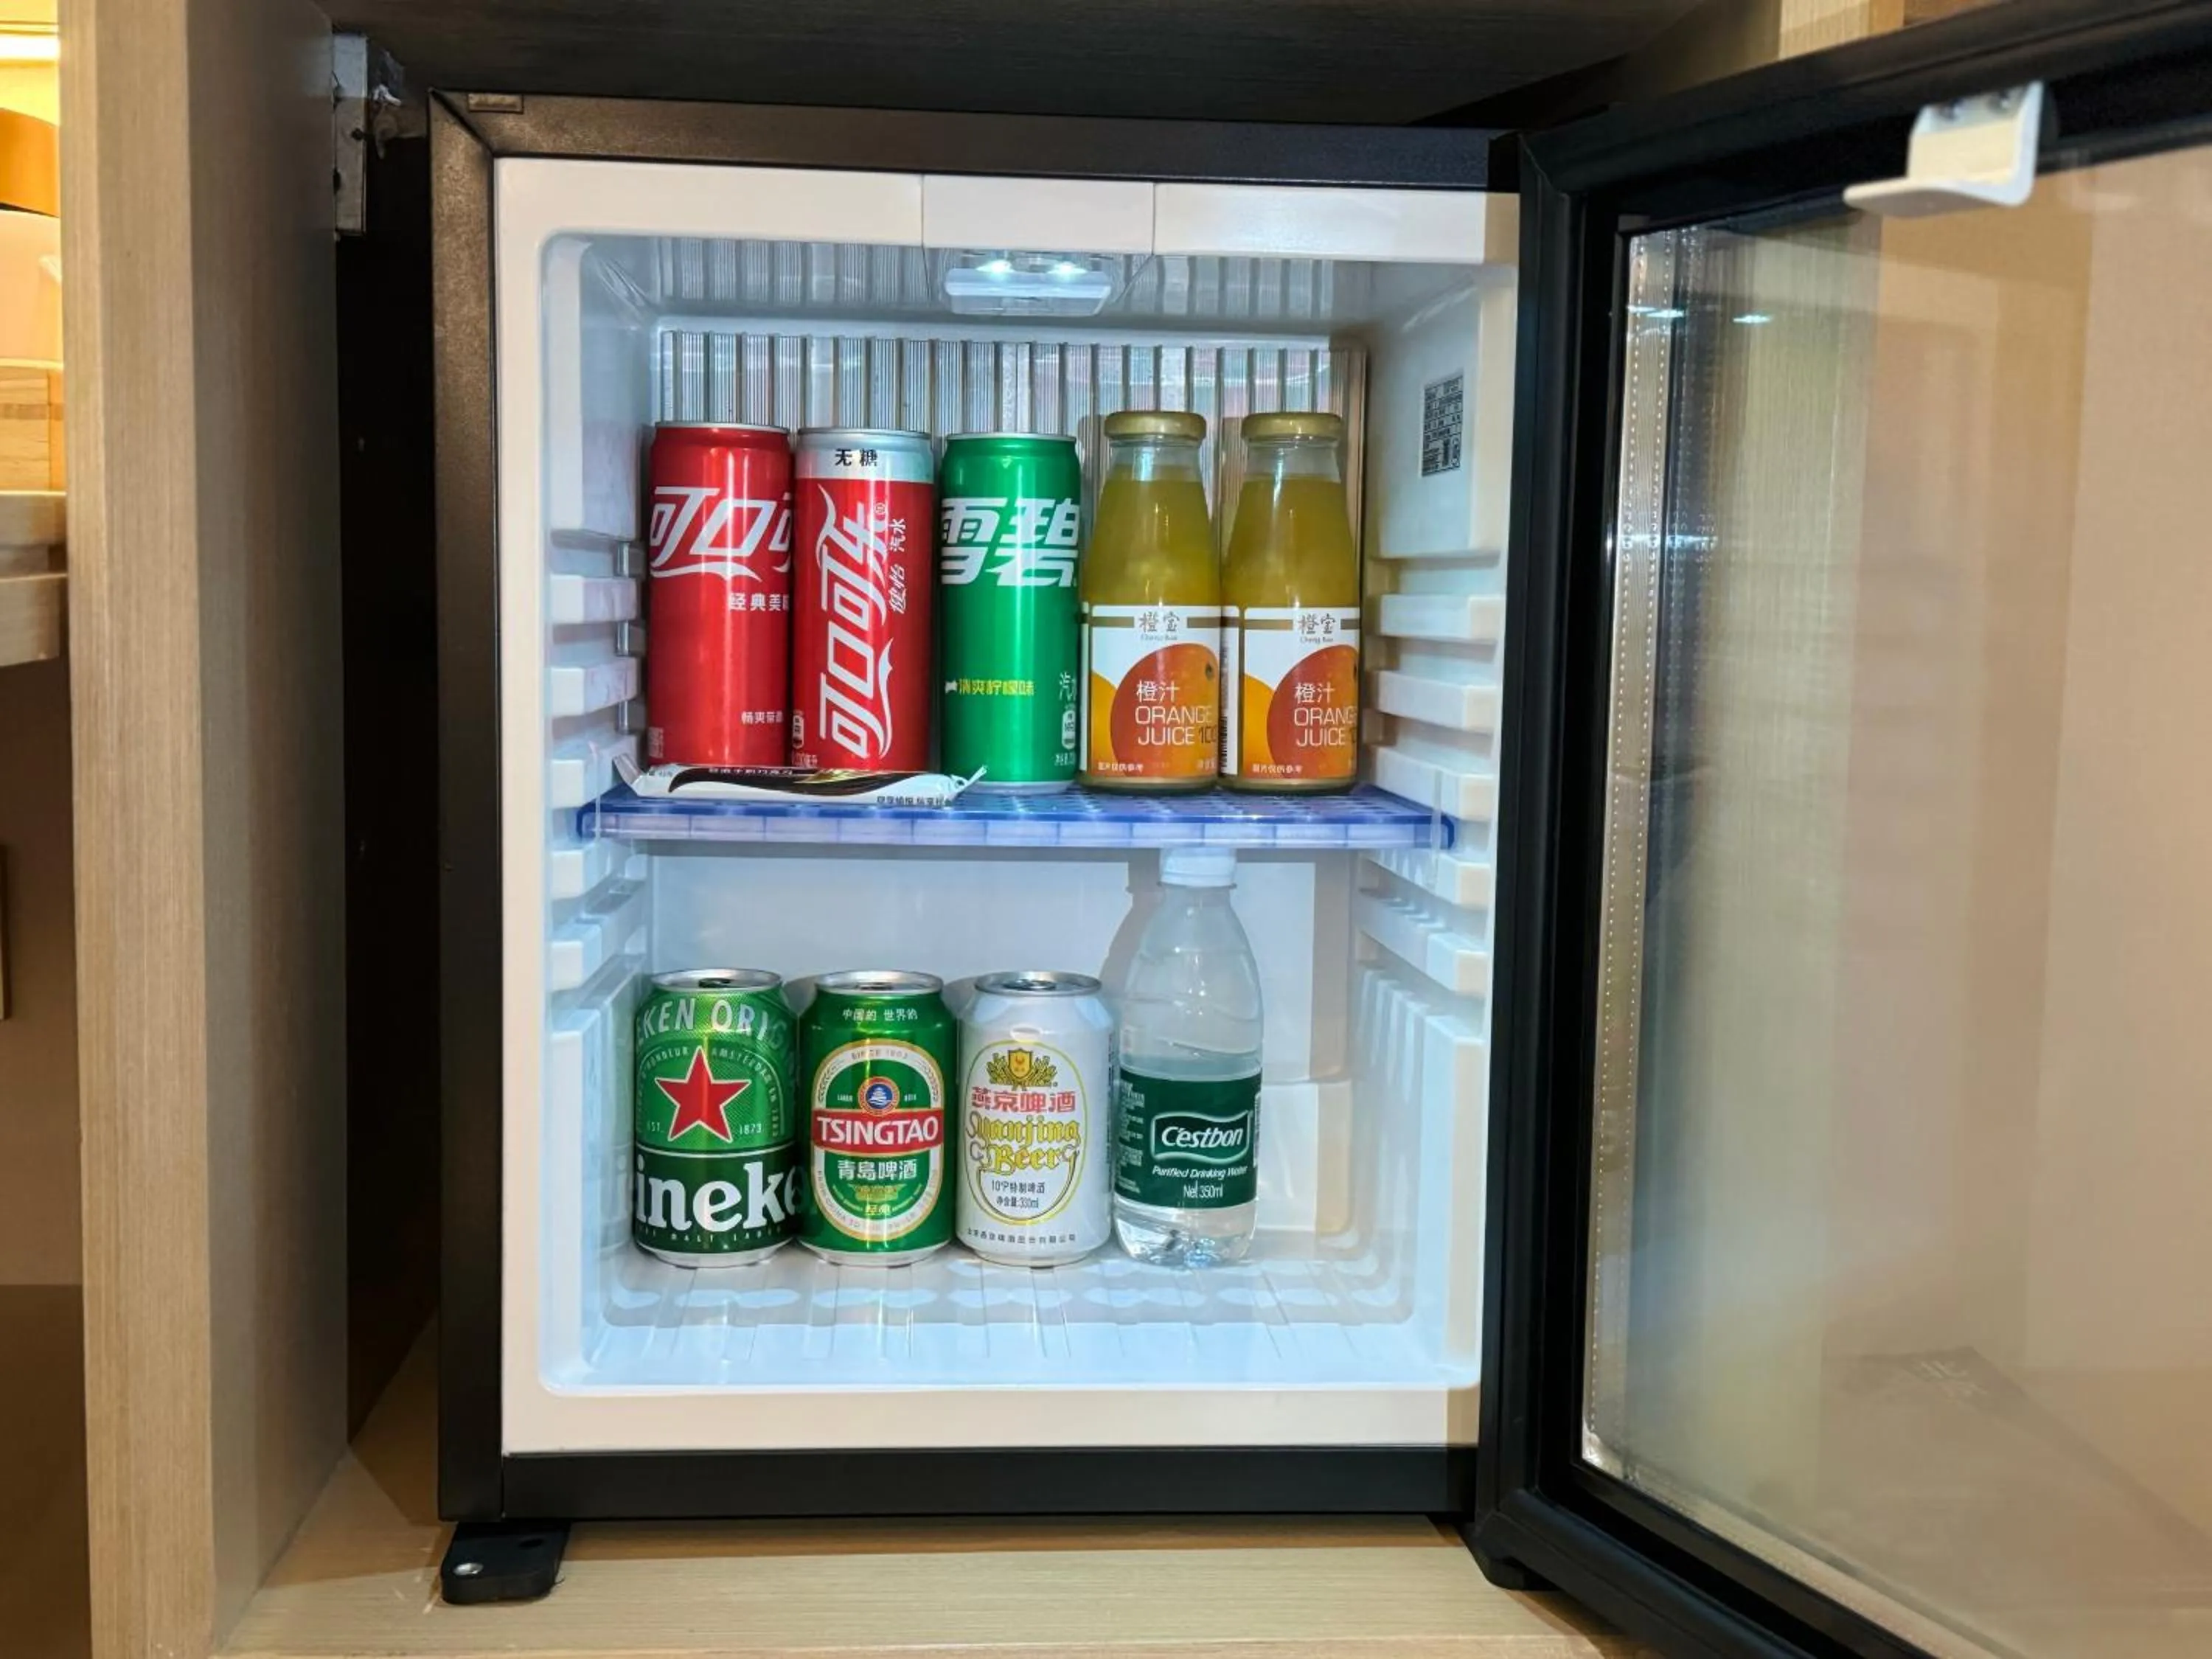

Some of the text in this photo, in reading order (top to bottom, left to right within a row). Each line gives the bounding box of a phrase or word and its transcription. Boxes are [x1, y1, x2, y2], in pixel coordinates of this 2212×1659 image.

[835, 448, 878, 466] 无糖
[889, 518, 906, 552] 汽水
[942, 497, 1080, 587] 雪碧
[815, 484, 894, 759] 可口可乐
[1136, 679, 1180, 703] 橙汁
[1294, 682, 1335, 703] 橙汁
[1135, 705, 1212, 725] ORANGE
[1138, 726, 1195, 745] JUICE
[1296, 728, 1346, 747] JUICE
[842, 1009, 918, 1021] 中国的 世界的
[972, 1086, 1077, 1113] 燕京啤酒
[816, 1115, 939, 1146] TSINGTAO
[966, 1110, 1081, 1150] Yanjing
[838, 1159, 918, 1180] 青岛啤酒
[985, 1144, 1062, 1176] Beer
[1152, 1165, 1189, 1178] Purified
[1189, 1168, 1226, 1180] Drinking
